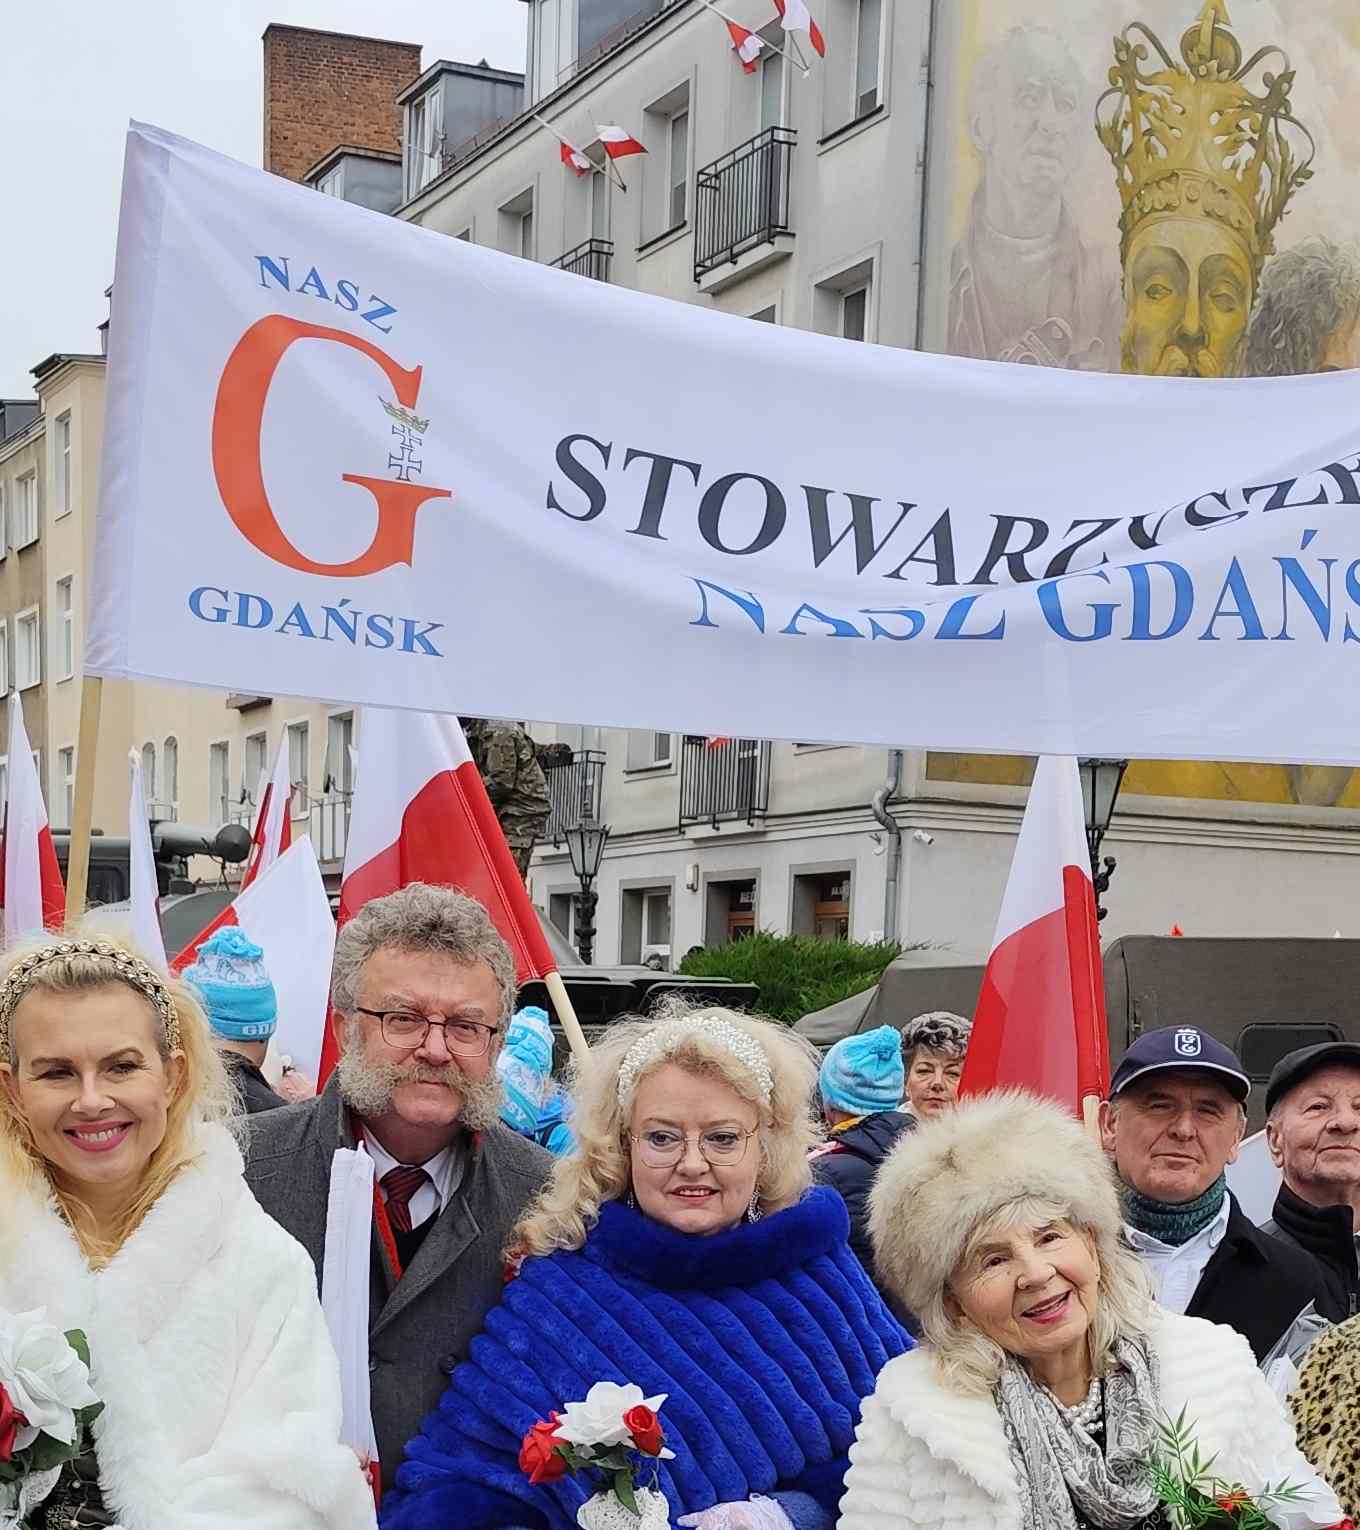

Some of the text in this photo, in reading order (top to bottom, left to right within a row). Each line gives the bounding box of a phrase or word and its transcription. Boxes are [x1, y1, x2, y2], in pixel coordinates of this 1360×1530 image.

[254, 254, 398, 335] NASZ
[211, 313, 453, 578] G
[187, 585, 445, 658] GDAŃSK
